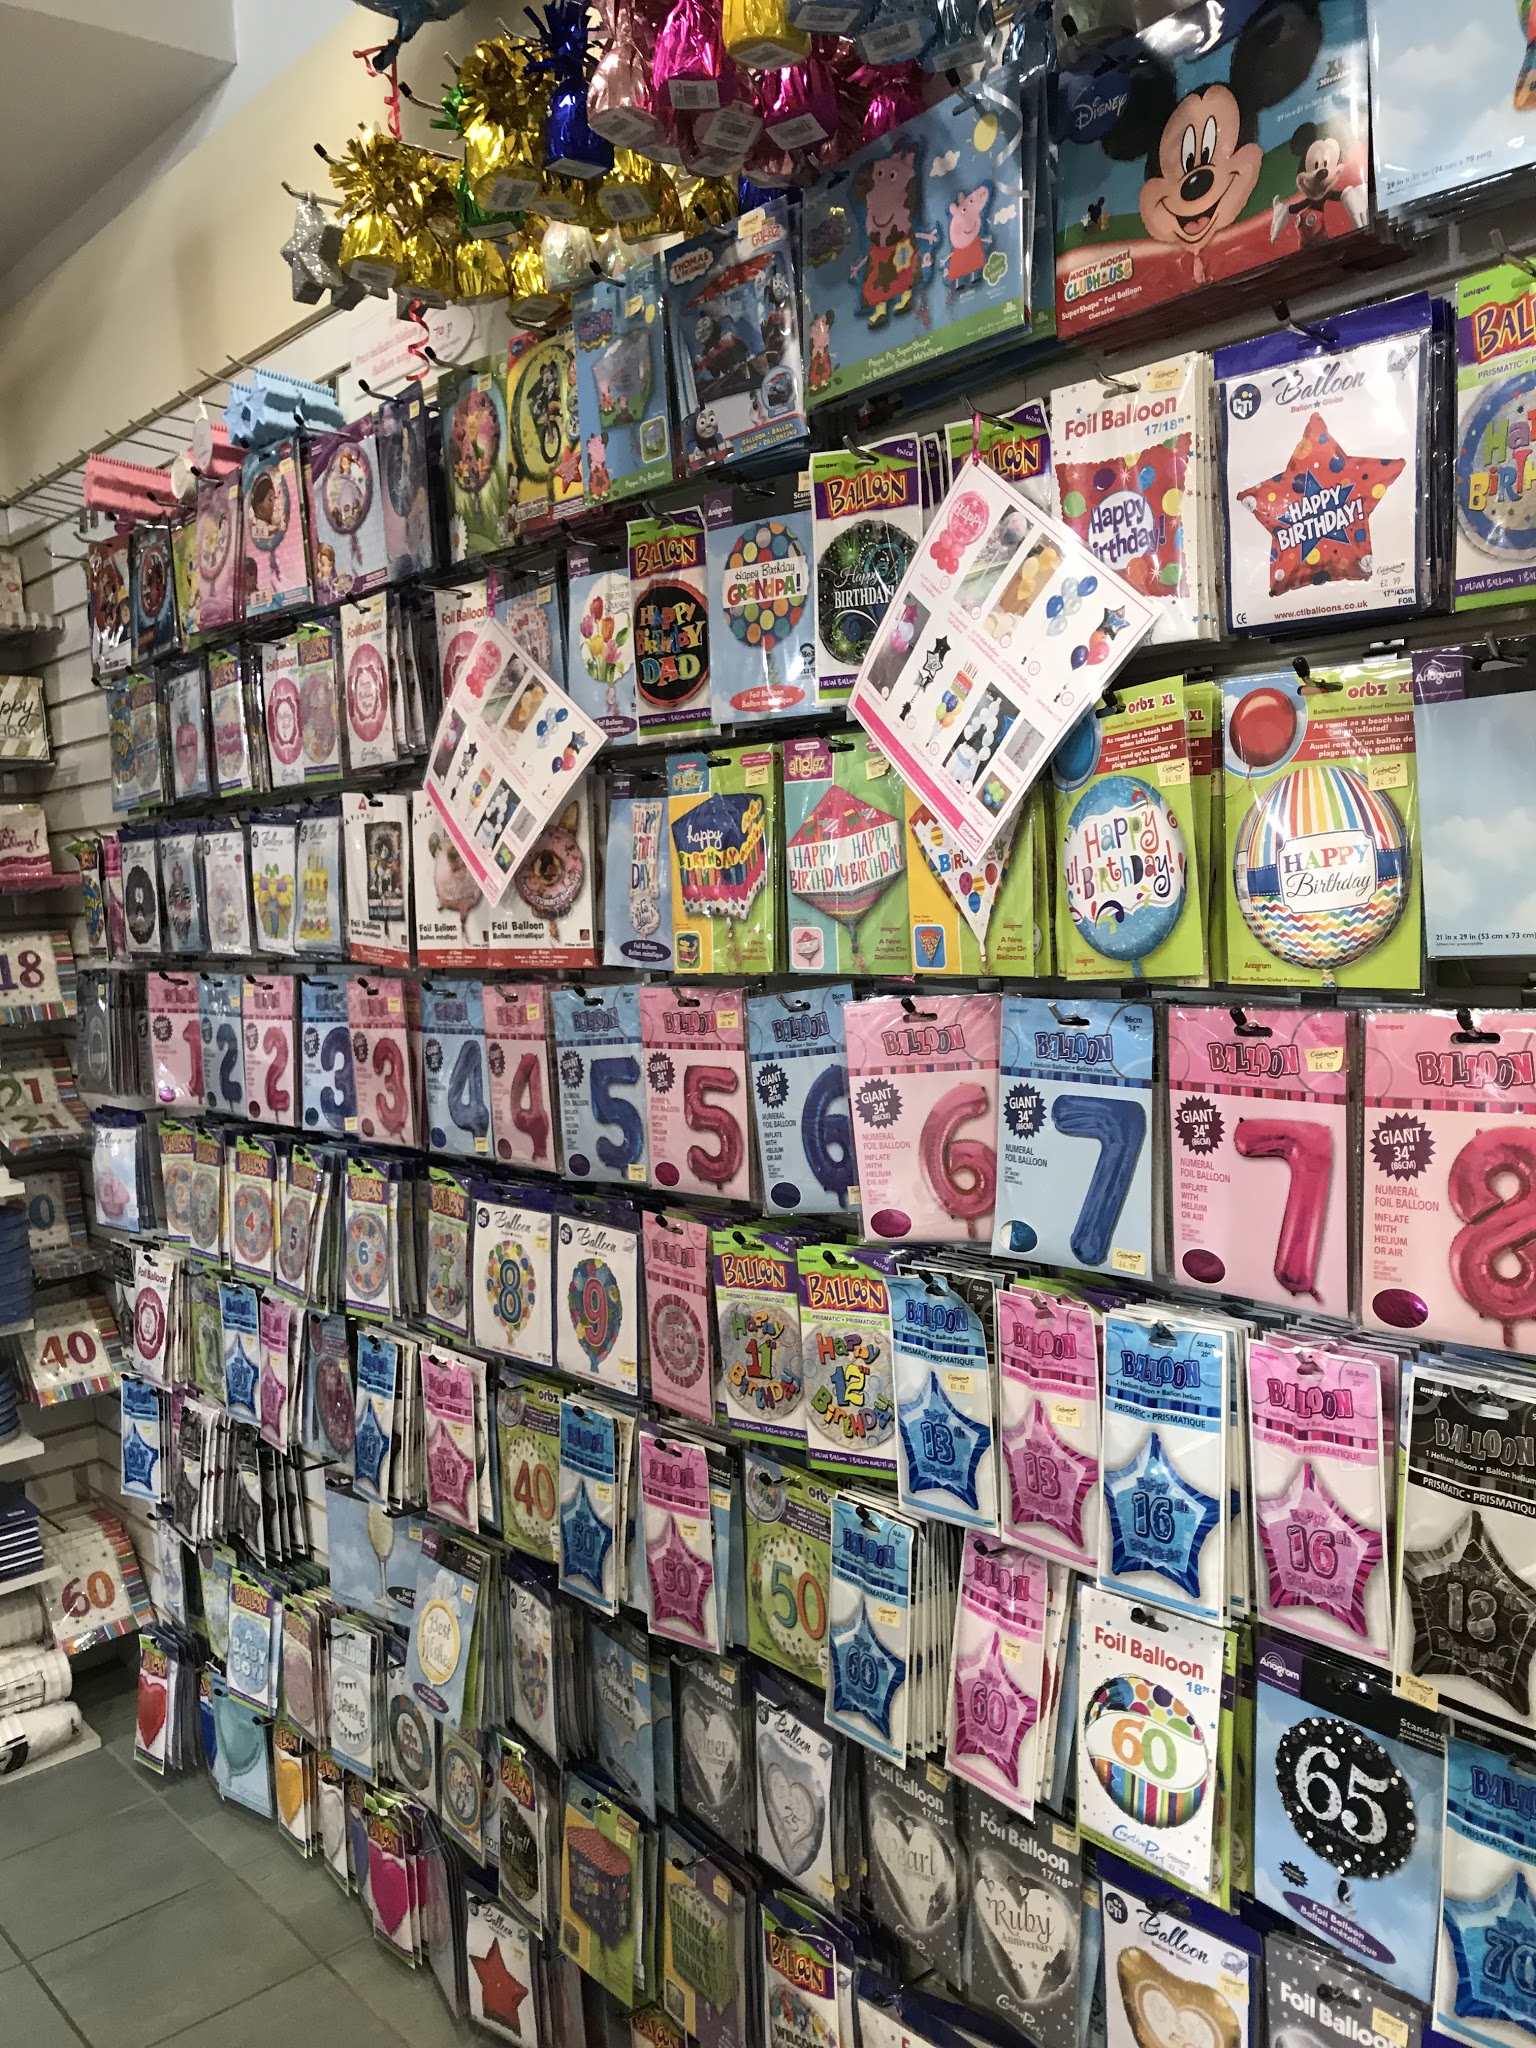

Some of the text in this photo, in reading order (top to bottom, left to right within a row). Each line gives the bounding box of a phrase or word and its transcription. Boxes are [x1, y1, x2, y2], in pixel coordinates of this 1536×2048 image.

[673, 252, 709, 274] THOMAS
[1069, 264, 1098, 280] MICKEY
[1065, 258, 1133, 301] CLUBHOUSE
[1463, 284, 1491, 299] unique
[1104, 295, 1116, 304] Foil
[1117, 285, 1142, 300] Balloon
[1088, 305, 1115, 320] Character
[1478, 359, 1522, 380] PRISMATIC
[1272, 361, 1365, 406] Balloon
[1065, 396, 1177, 441] Foil Balloon
[741, 422, 793, 446] BALLOON BALLON
[826, 467, 907, 519] BALLOON
[1289, 484, 1342, 521] HAPPY
[1091, 497, 1146, 532] Happy
[1277, 496, 1364, 551] BIRTHDAY!
[1092, 517, 1166, 564] irthday!
[735, 562, 795, 584] Happy Birthday
[833, 567, 879, 588] Happy
[1274, 600, 1367, 620] www.ctiballoons.co.uk
[1398, 596, 1415, 605] FOIL
[642, 654, 701, 686] DAD
[1415, 668, 1462, 685] Anagram
[1348, 682, 1387, 698] orbz
[1129, 694, 1175, 713] orbz XL
[1326, 720, 1347, 728] round
[1369, 716, 1392, 724] beach
[1356, 724, 1388, 733] inflated!
[788, 752, 828, 778] anglez
[1319, 750, 1339, 758] plage
[1376, 776, 1397, 786] £4.99
[687, 825, 723, 849] happy
[852, 825, 892, 853] HAPPY
[1084, 809, 1159, 864] Happy
[793, 845, 836, 869] HAPPY
[850, 843, 903, 884] BIRTHDAY
[1283, 843, 1371, 873] HAPPY
[790, 867, 850, 892] BIRTHDAY
[1286, 872, 1372, 898] Birthday
[492, 921, 544, 931] Foil Balloon
[1470, 932, 1476, 940] in
[1478, 931, 1490, 942] (53
[996, 945, 1014, 953] Angle
[0, 950, 44, 988] 18
[772, 1012, 829, 1042] BALLOON
[881, 1022, 966, 1058] BALLOON
[1035, 1033, 1114, 1065] BALLOON
[1208, 1043, 1300, 1077] BALLOON
[1315, 1061, 1334, 1070] £6.99
[1417, 1051, 1535, 1089] BALLOON
[1008, 1096, 1037, 1109] GIANT
[1380, 1128, 1421, 1145] GIANT
[1005, 1144, 1034, 1156] NUMERAL
[1005, 1154, 1048, 1167] FOIL BALLOON
[1394, 1145, 1415, 1161] 34"
[1391, 1160, 1416, 1171] (86CM)
[1051, 1094, 1146, 1266] 7
[1375, 1185, 1419, 1198] NUMERAL
[1234, 1118, 1331, 1293] 7
[1375, 1197, 1439, 1212] FOIL BALLOON
[245, 1212, 255, 1232] 4
[1375, 1213, 1410, 1224] INFLATE
[1375, 1224, 1397, 1233] WITH
[289, 1228, 297, 1250] 5
[1374, 1235, 1408, 1247] HELIUM
[1374, 1246, 1403, 1257] OR AIR
[358, 1241, 368, 1265] 6
[499, 1258, 521, 1324] 8
[808, 1275, 885, 1309] BALLOON
[582, 1278, 609, 1347] 9
[812, 1314, 882, 1326] PRISMATIC PRISMATIQUE
[905, 1300, 968, 1333] BALLOON
[40, 1331, 96, 1368] 40
[1121, 1351, 1201, 1389] BALLOON
[1114, 1403, 1205, 1428] PRISMATIC PRISMATIQUE
[1435, 1418, 1535, 1467] BALLOON
[1431, 1451, 1453, 1463] Helium
[1486, 1466, 1510, 1478] Ballon
[514, 1460, 555, 1521] 40
[1423, 1477, 1536, 1516] PRISMATIC PRISMATIQU
[61, 1570, 115, 1618] 60
[770, 1561, 826, 1640] 50
[1095, 1626, 1203, 1680] Foil Balloon
[1260, 1655, 1300, 1682] Anagram
[1112, 1718, 1177, 1780] 60
[1295, 1744, 1389, 1846] 65
[883, 1834, 935, 1877] Pearl
[980, 1811, 1070, 1874] Foil Balloon
[987, 1895, 1054, 1945] Ruby
[1300, 1905, 1328, 1929] Ballon
[1312, 1903, 1365, 1940] Foil Balloon
[1000, 1932, 1054, 1954] Anniversary
[1136, 1907, 1209, 1965] Balloon
[1280, 1982, 1316, 2019] Foil
